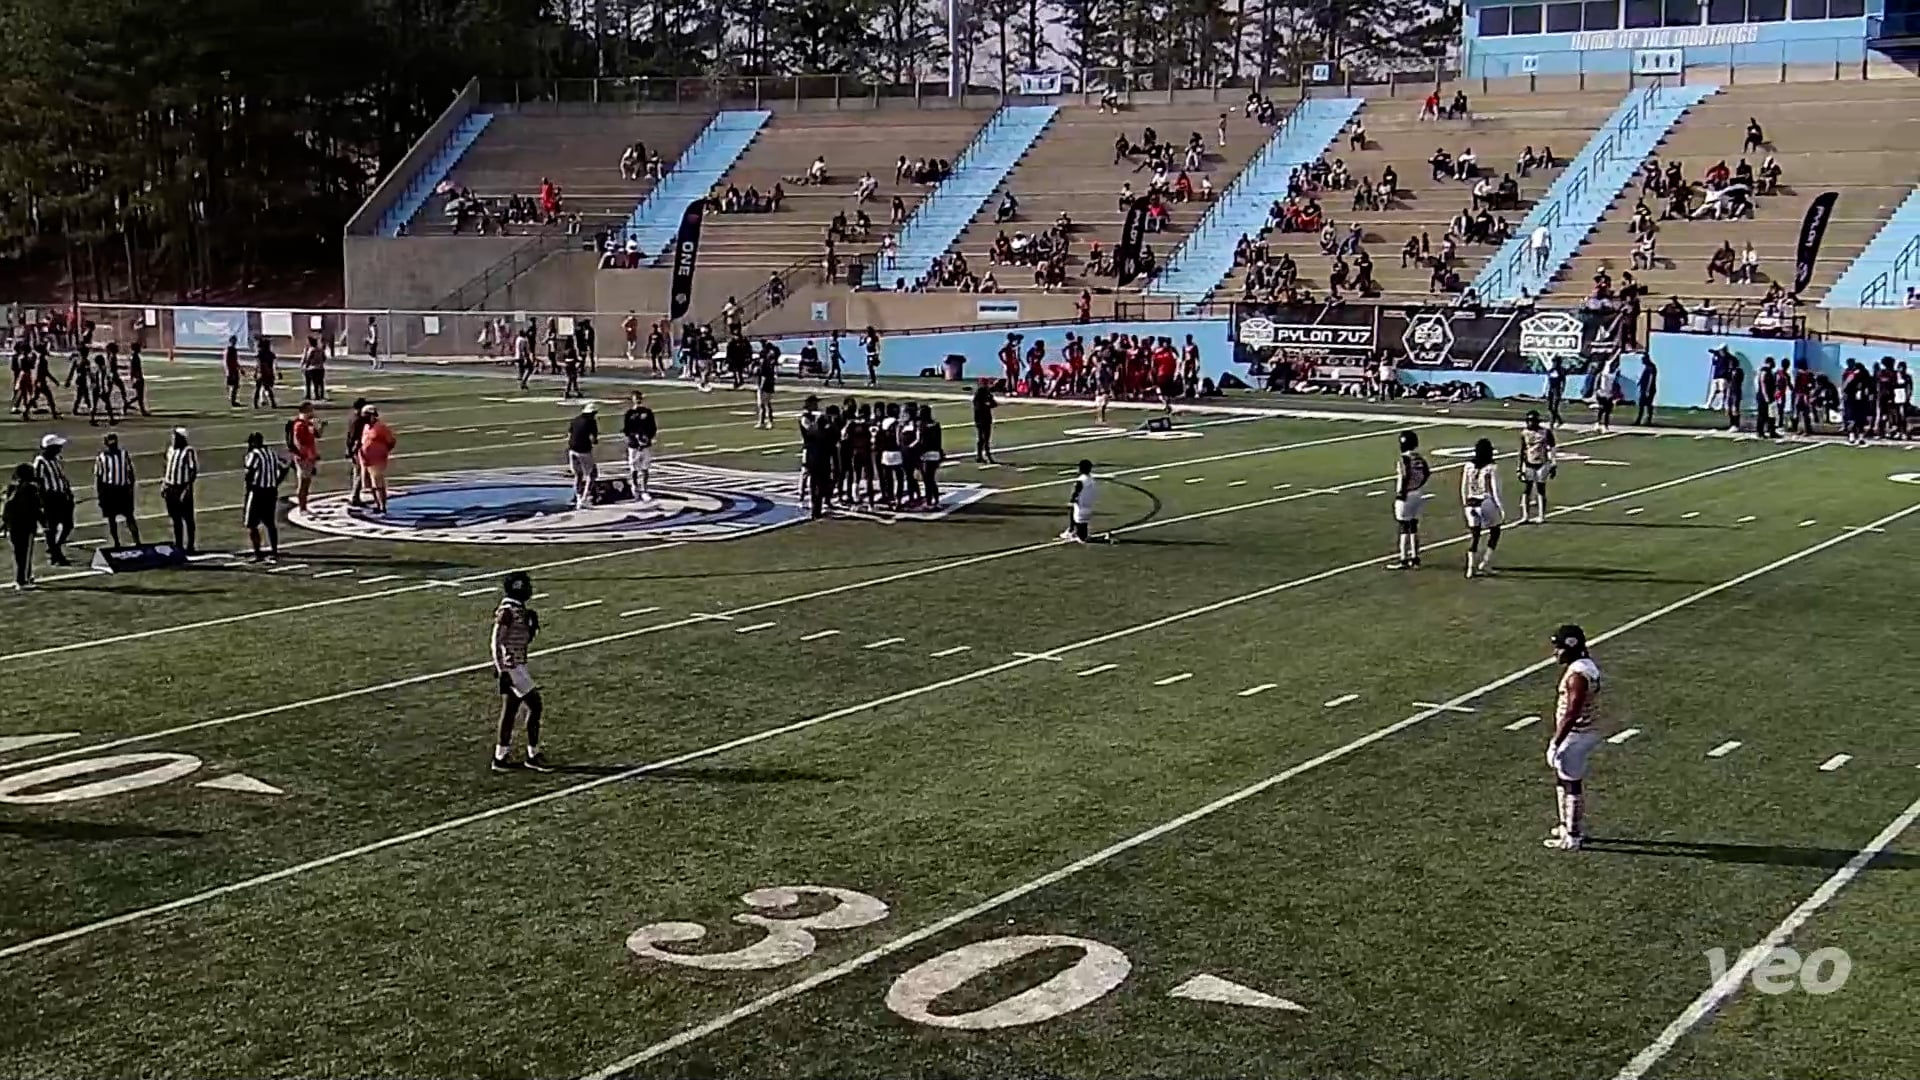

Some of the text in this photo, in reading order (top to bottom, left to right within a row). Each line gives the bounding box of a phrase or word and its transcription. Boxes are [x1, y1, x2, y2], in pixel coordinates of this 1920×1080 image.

[678, 242, 694, 276] ONE
[1278, 329, 1332, 342] PYLON
[1525, 335, 1576, 348] PYLON
